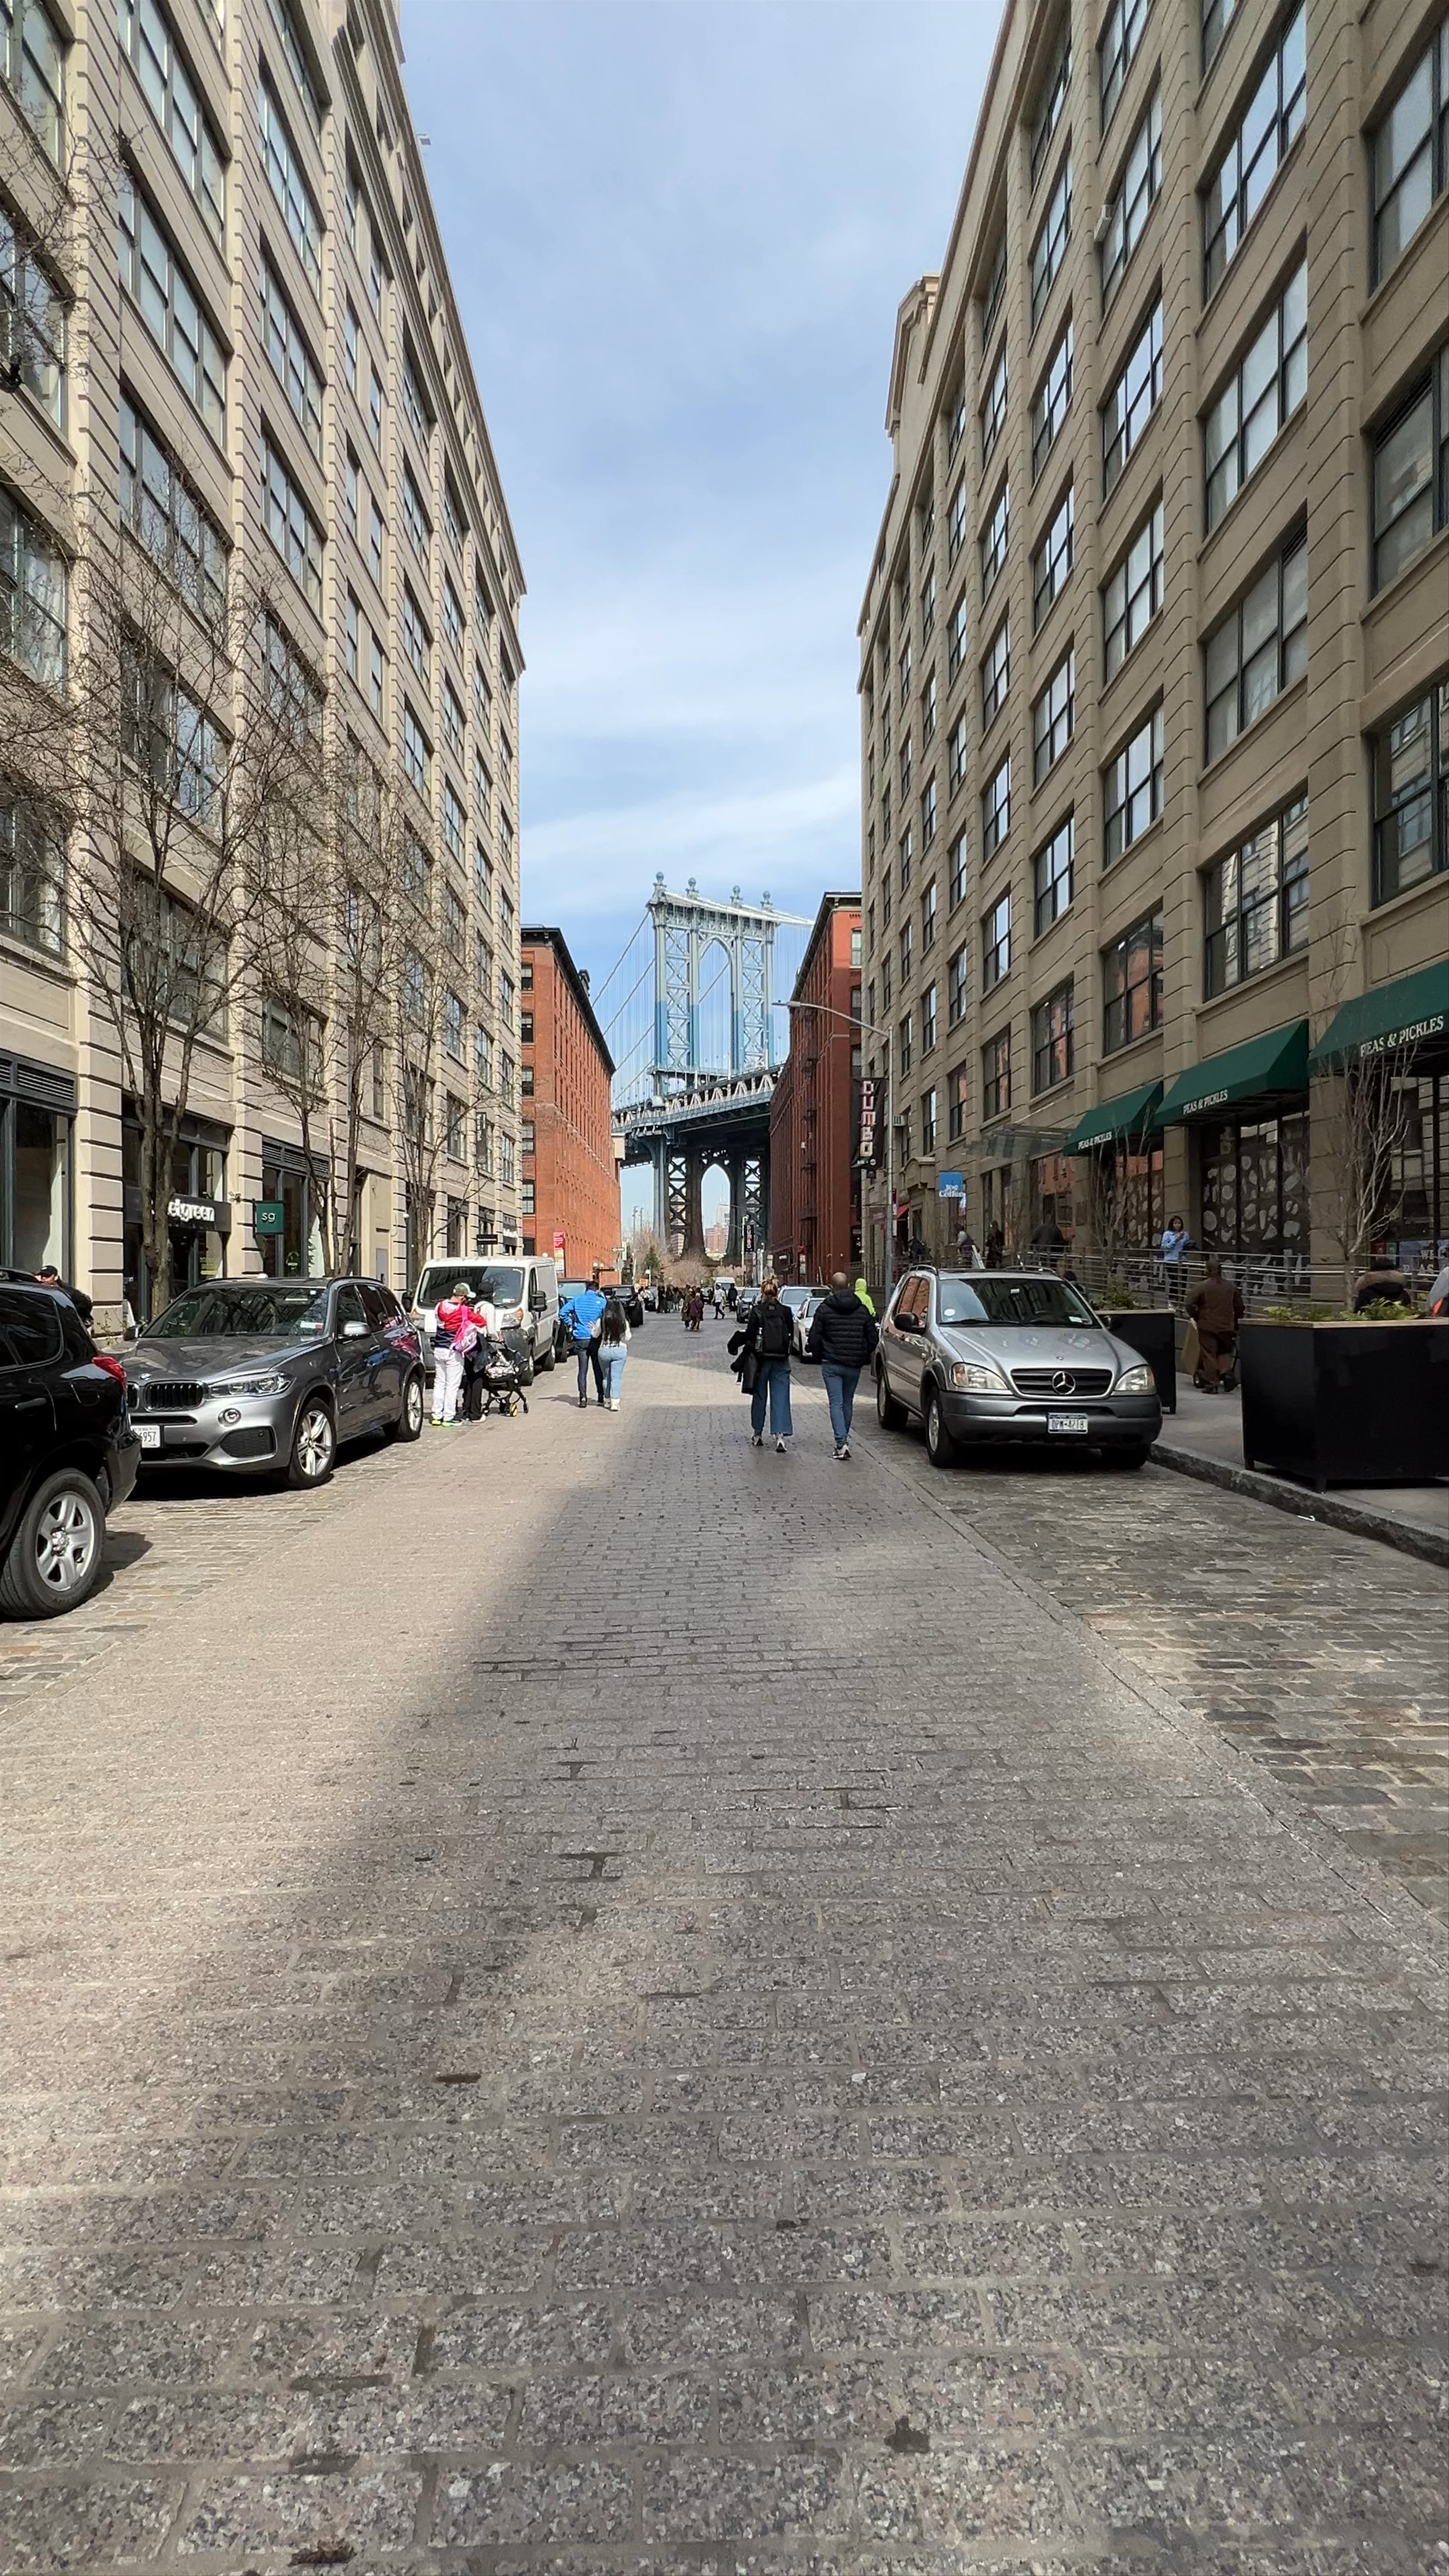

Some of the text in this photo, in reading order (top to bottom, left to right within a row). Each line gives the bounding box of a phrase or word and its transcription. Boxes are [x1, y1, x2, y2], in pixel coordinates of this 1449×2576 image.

[1360, 1015, 1444, 1057] PEAS & PICKLES
[860, 1080, 876, 1157] DUMBO
[1183, 1089, 1228, 1115] PEAS & PICKLES
[261, 1212, 276, 1222] sg
